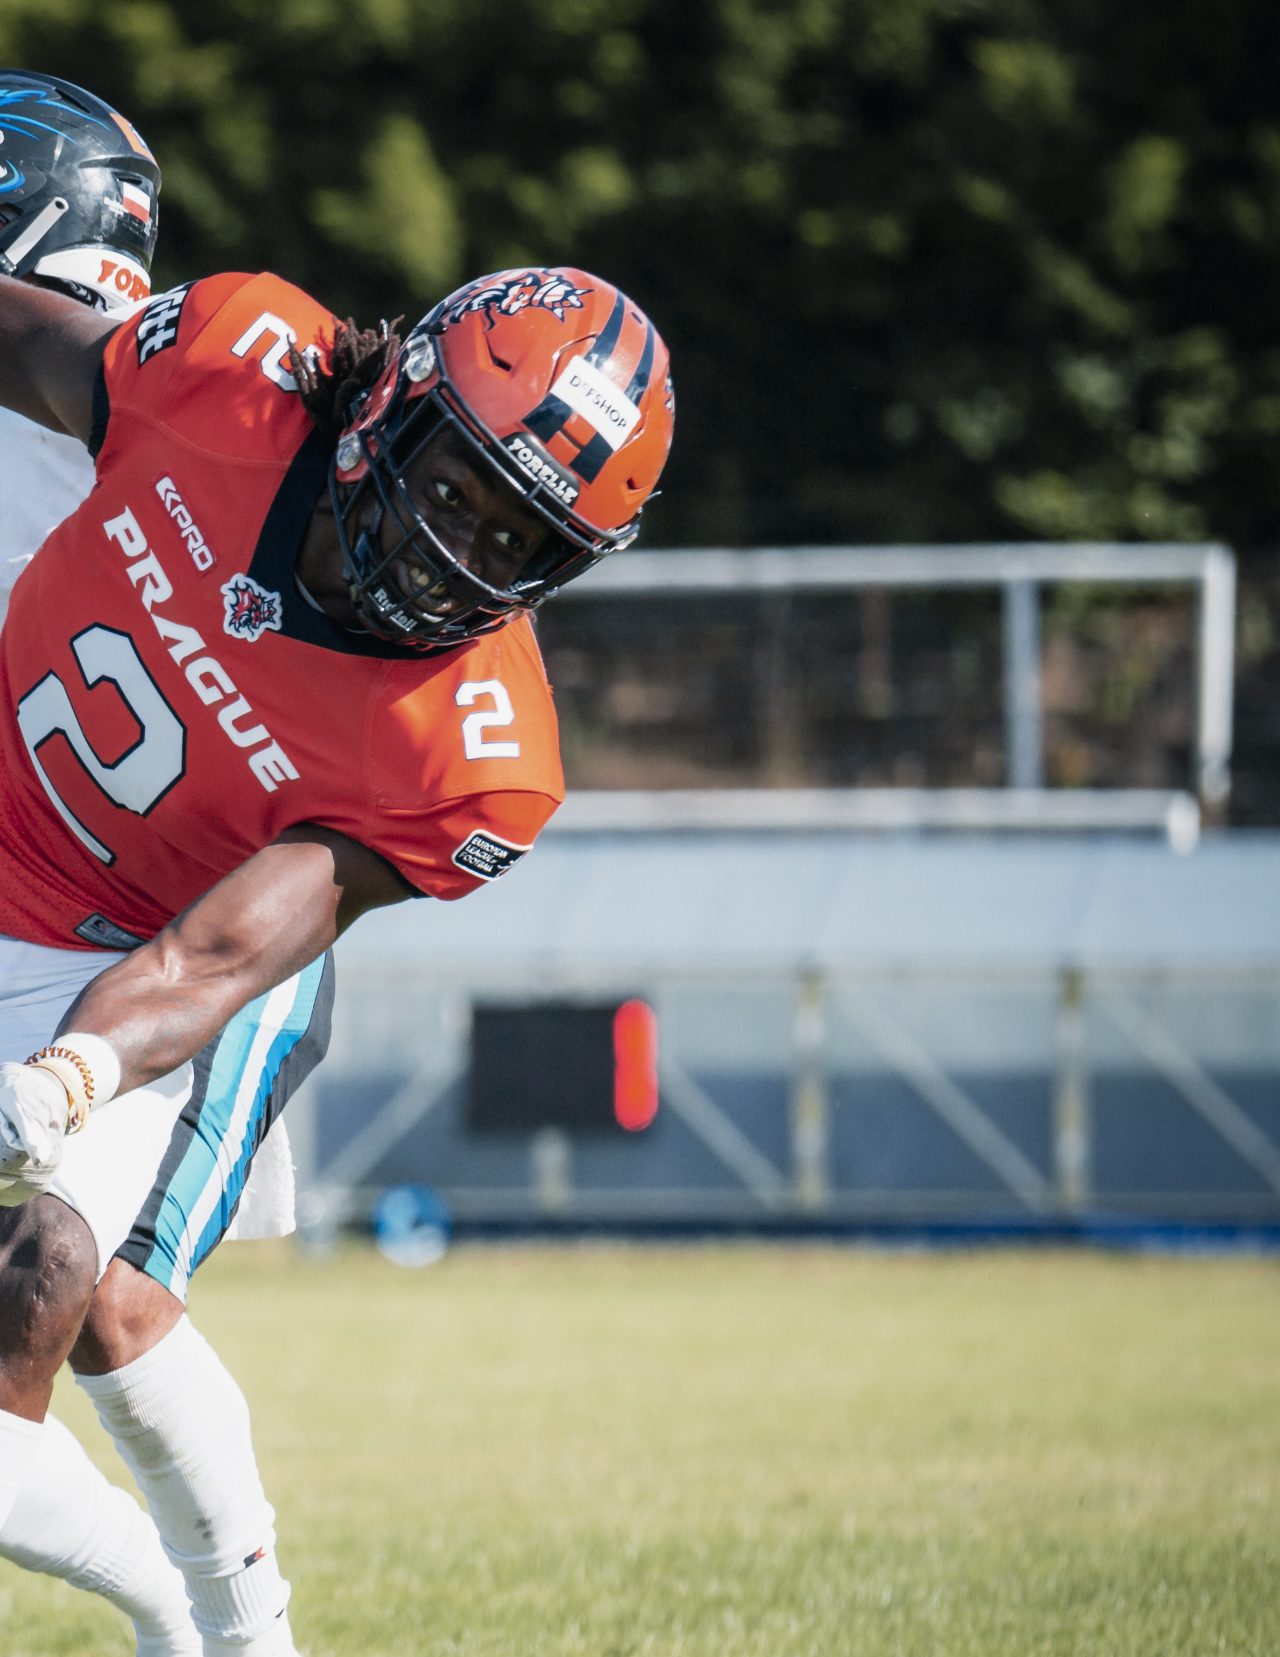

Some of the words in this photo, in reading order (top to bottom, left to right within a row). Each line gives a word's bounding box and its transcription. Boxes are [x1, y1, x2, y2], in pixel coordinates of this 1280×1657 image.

[17, 621, 188, 867] 2
[103, 505, 301, 793] PRAGUE
[454, 679, 521, 761] 2
